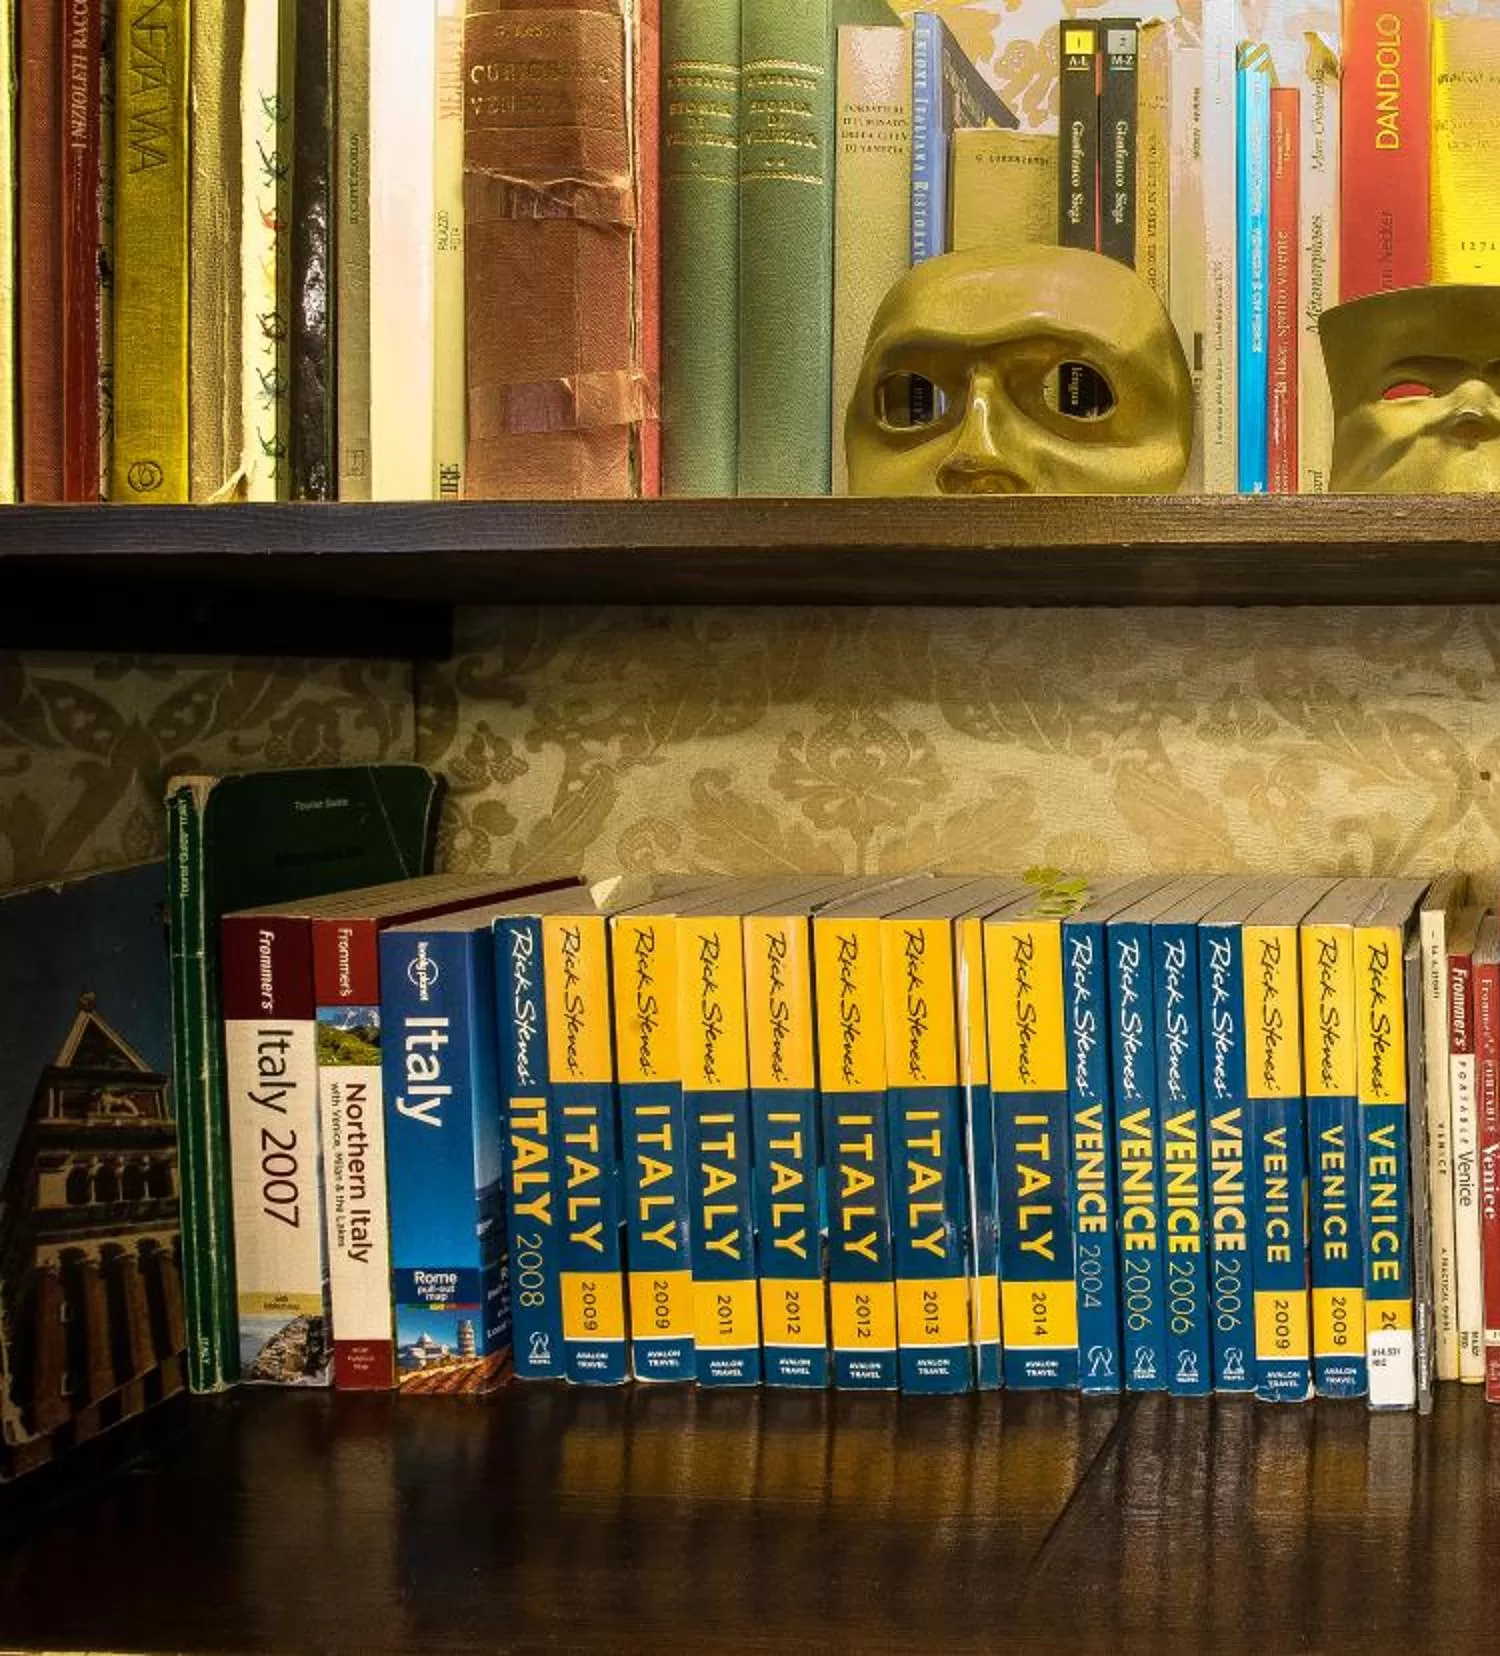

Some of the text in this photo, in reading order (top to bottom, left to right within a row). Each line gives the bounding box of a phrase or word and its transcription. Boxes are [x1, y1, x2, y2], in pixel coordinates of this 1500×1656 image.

[1376, 14, 1401, 150] DANDOLO
[1070, 120, 1085, 187] Gianfranco
[1114, 120, 1129, 187] Gianfranco
[338, 928, 354, 997] Frommer's
[511, 928, 538, 989] Rick
[698, 933, 722, 996] Rick
[1368, 942, 1392, 1004] Rick
[249, 929, 300, 1228] Frommer's Italy 2007
[396, 1016, 452, 1127] Italy
[345, 1082, 374, 1265] Northern Italy
[509, 1096, 553, 1309] ITALY 2008
[562, 1104, 604, 1251] ITALY
[699, 1113, 741, 1261] ITALY
[767, 1111, 808, 1260] ITALY
[904, 1109, 946, 1260] ITALY
[1014, 1113, 1056, 1263] ITALY
[1074, 1103, 1108, 1309] VENICE 2004
[1119, 1107, 1158, 1331] VENICE 2006
[1210, 1106, 1247, 1332] VENICE 2006
[1320, 1124, 1348, 1261] VENICE
[1369, 1122, 1400, 1281] VENICE
[1459, 1149, 1478, 1207] Venice
[1482, 1142, 1500, 1219] Venice
[413, 1270, 458, 1286] Rome
[581, 1281, 599, 1331] 2009
[716, 1294, 734, 1335] 2011
[784, 1289, 801, 1334] 2012
[922, 1290, 940, 1335] 2013
[1030, 1291, 1048, 1336] 2014
[1331, 1295, 1348, 1346] 2009
